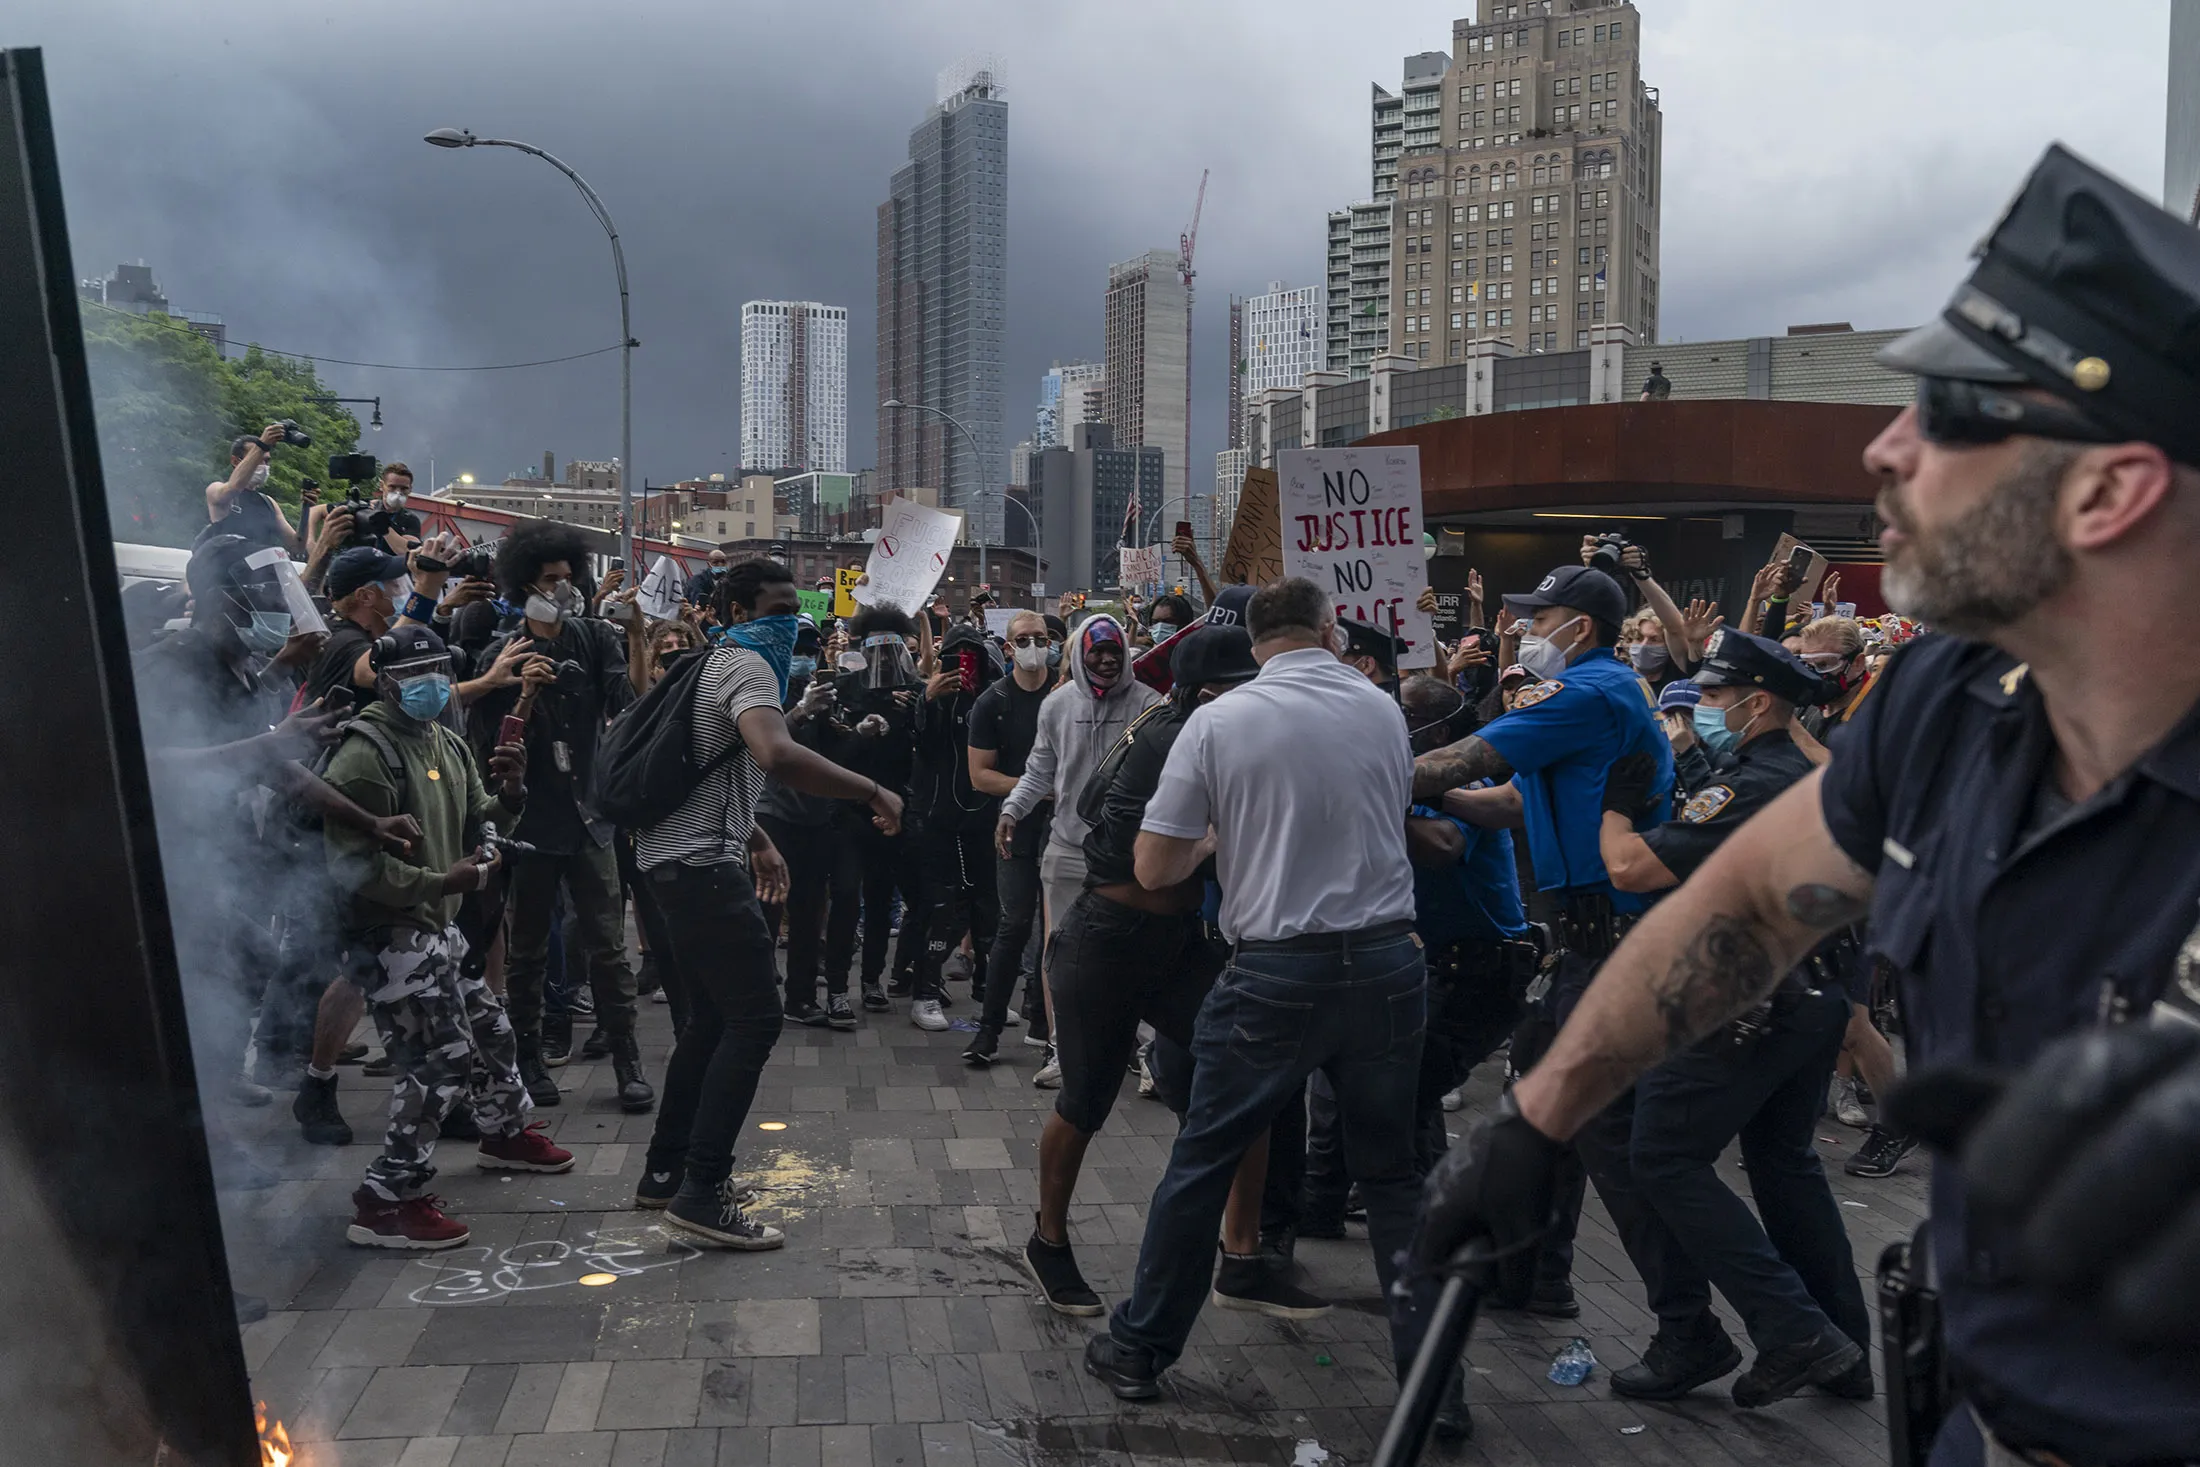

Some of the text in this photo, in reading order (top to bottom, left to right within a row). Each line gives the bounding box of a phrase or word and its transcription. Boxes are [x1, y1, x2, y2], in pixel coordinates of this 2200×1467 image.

[583, 461, 617, 470] YWCA
[1323, 468, 1370, 508] NO
[1295, 507, 1414, 552] JUSTICE
[1123, 548, 1157, 562] BLACK
[1125, 569, 1160, 582] MATTER
[1333, 559, 1373, 594] NO
[799, 597, 825, 610] RGE
[1204, 605, 1238, 627] YPD
